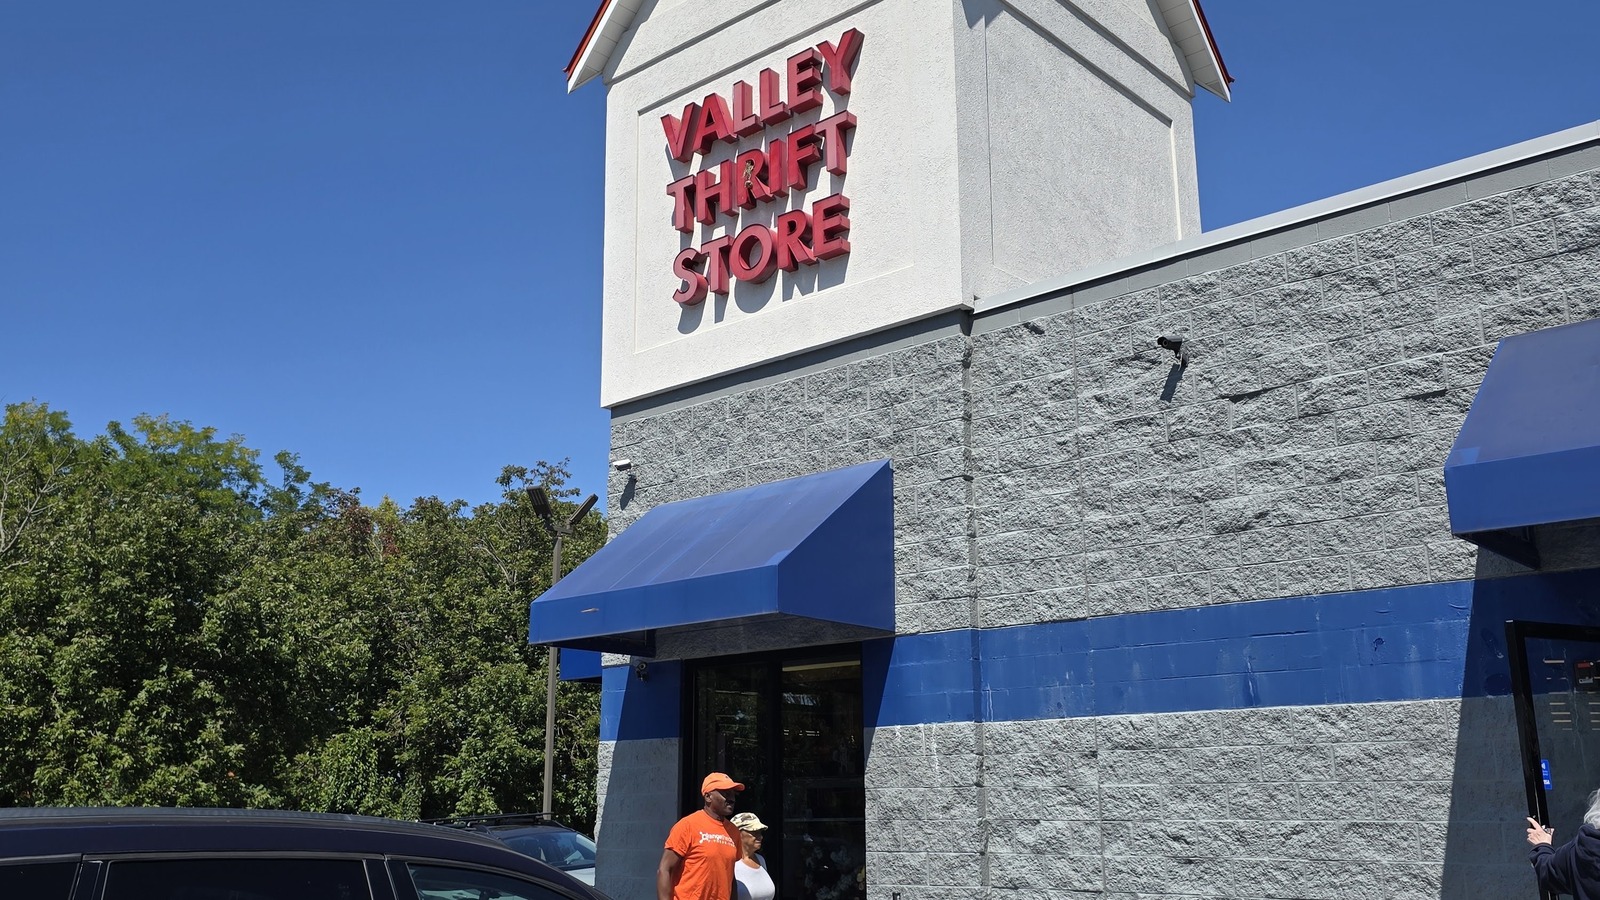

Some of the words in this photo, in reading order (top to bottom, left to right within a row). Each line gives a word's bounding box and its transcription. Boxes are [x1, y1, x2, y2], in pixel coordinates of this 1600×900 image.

[660, 27, 865, 163] VALLEY
[666, 110, 857, 234] THRIFT
[672, 193, 850, 306] STORE
